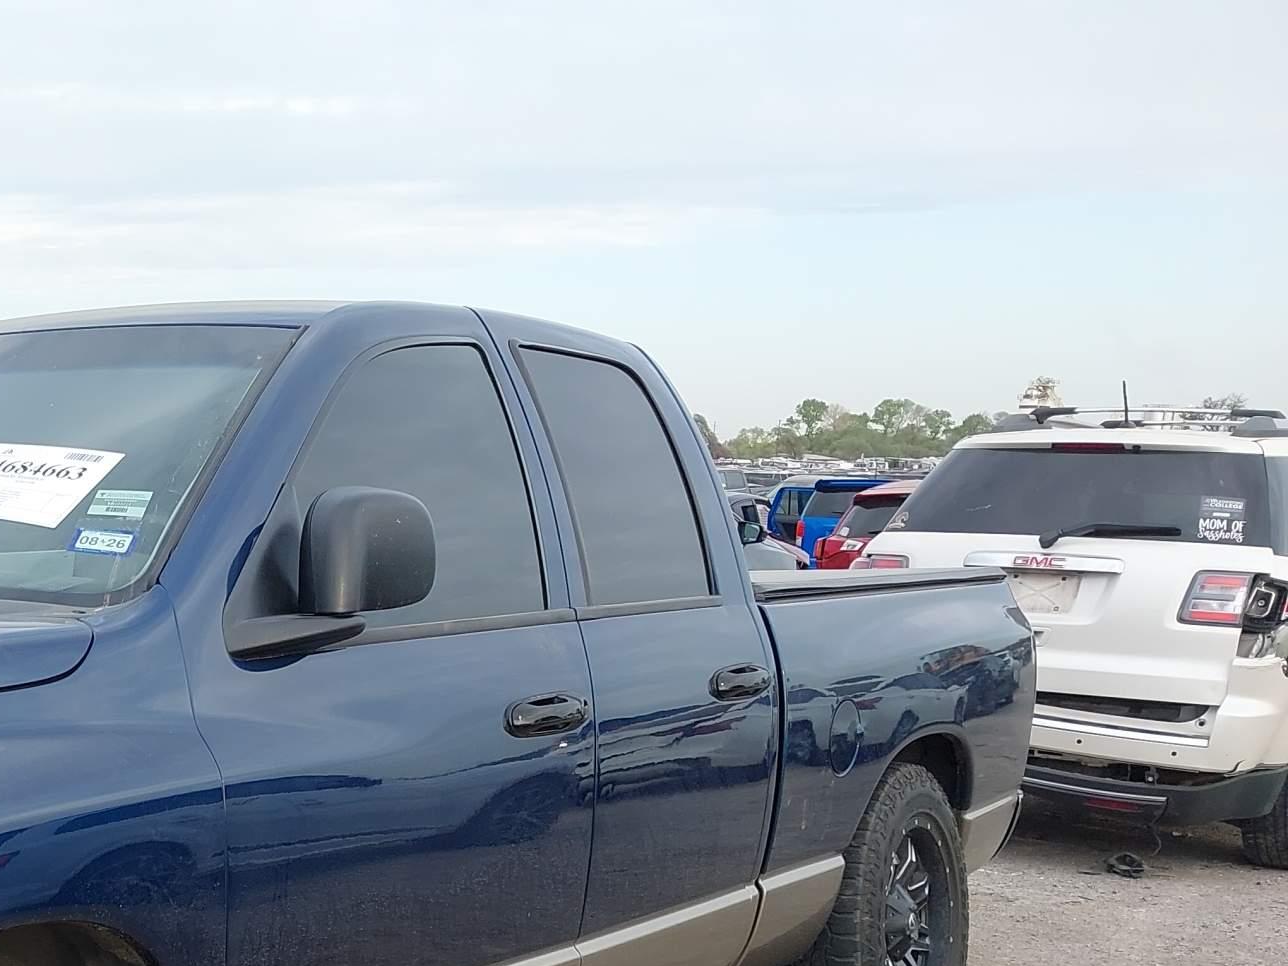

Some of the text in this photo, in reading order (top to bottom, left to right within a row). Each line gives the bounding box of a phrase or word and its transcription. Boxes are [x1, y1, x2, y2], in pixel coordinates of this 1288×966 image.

[1198, 518, 1247, 532] MOM OF
[1013, 556, 1067, 569] GMC
